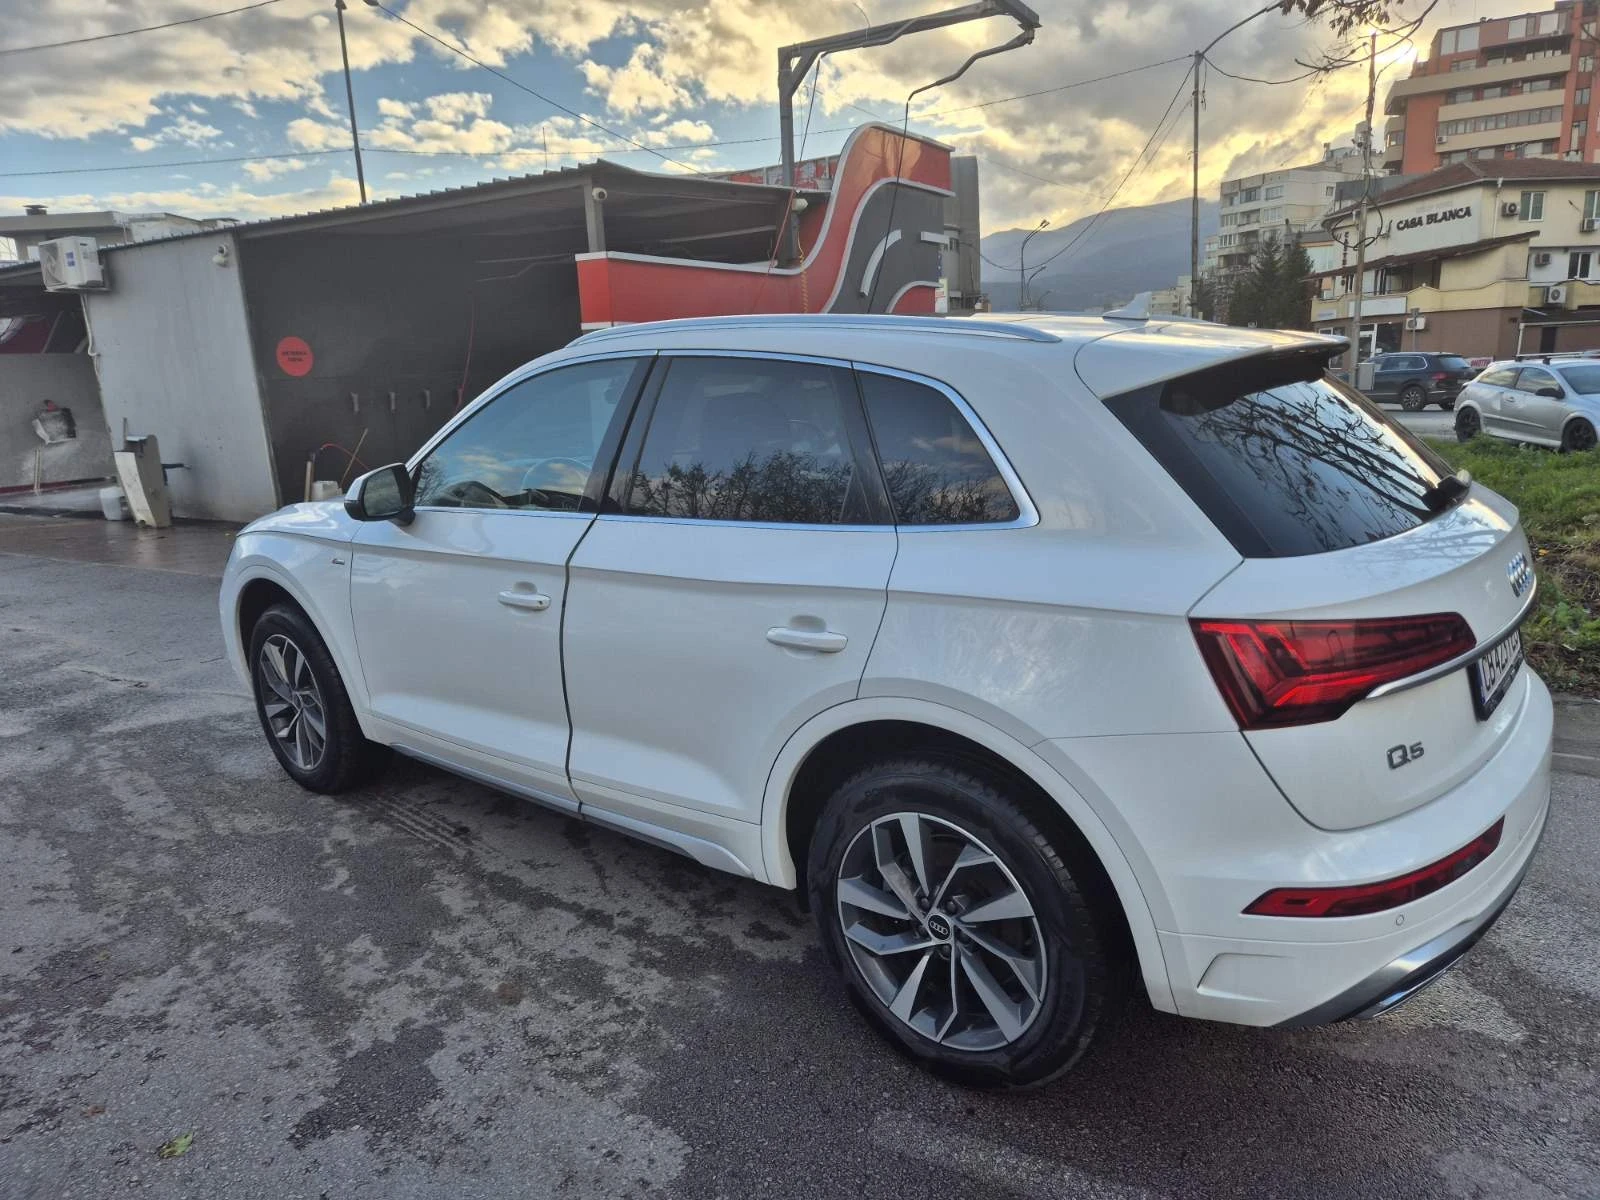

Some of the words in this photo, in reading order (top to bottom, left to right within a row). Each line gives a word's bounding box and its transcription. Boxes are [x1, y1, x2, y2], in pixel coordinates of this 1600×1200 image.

[1397, 216, 1424, 231] CASA
[1426, 206, 1472, 225] BLANCA
[1386, 741, 1424, 770] Q5
